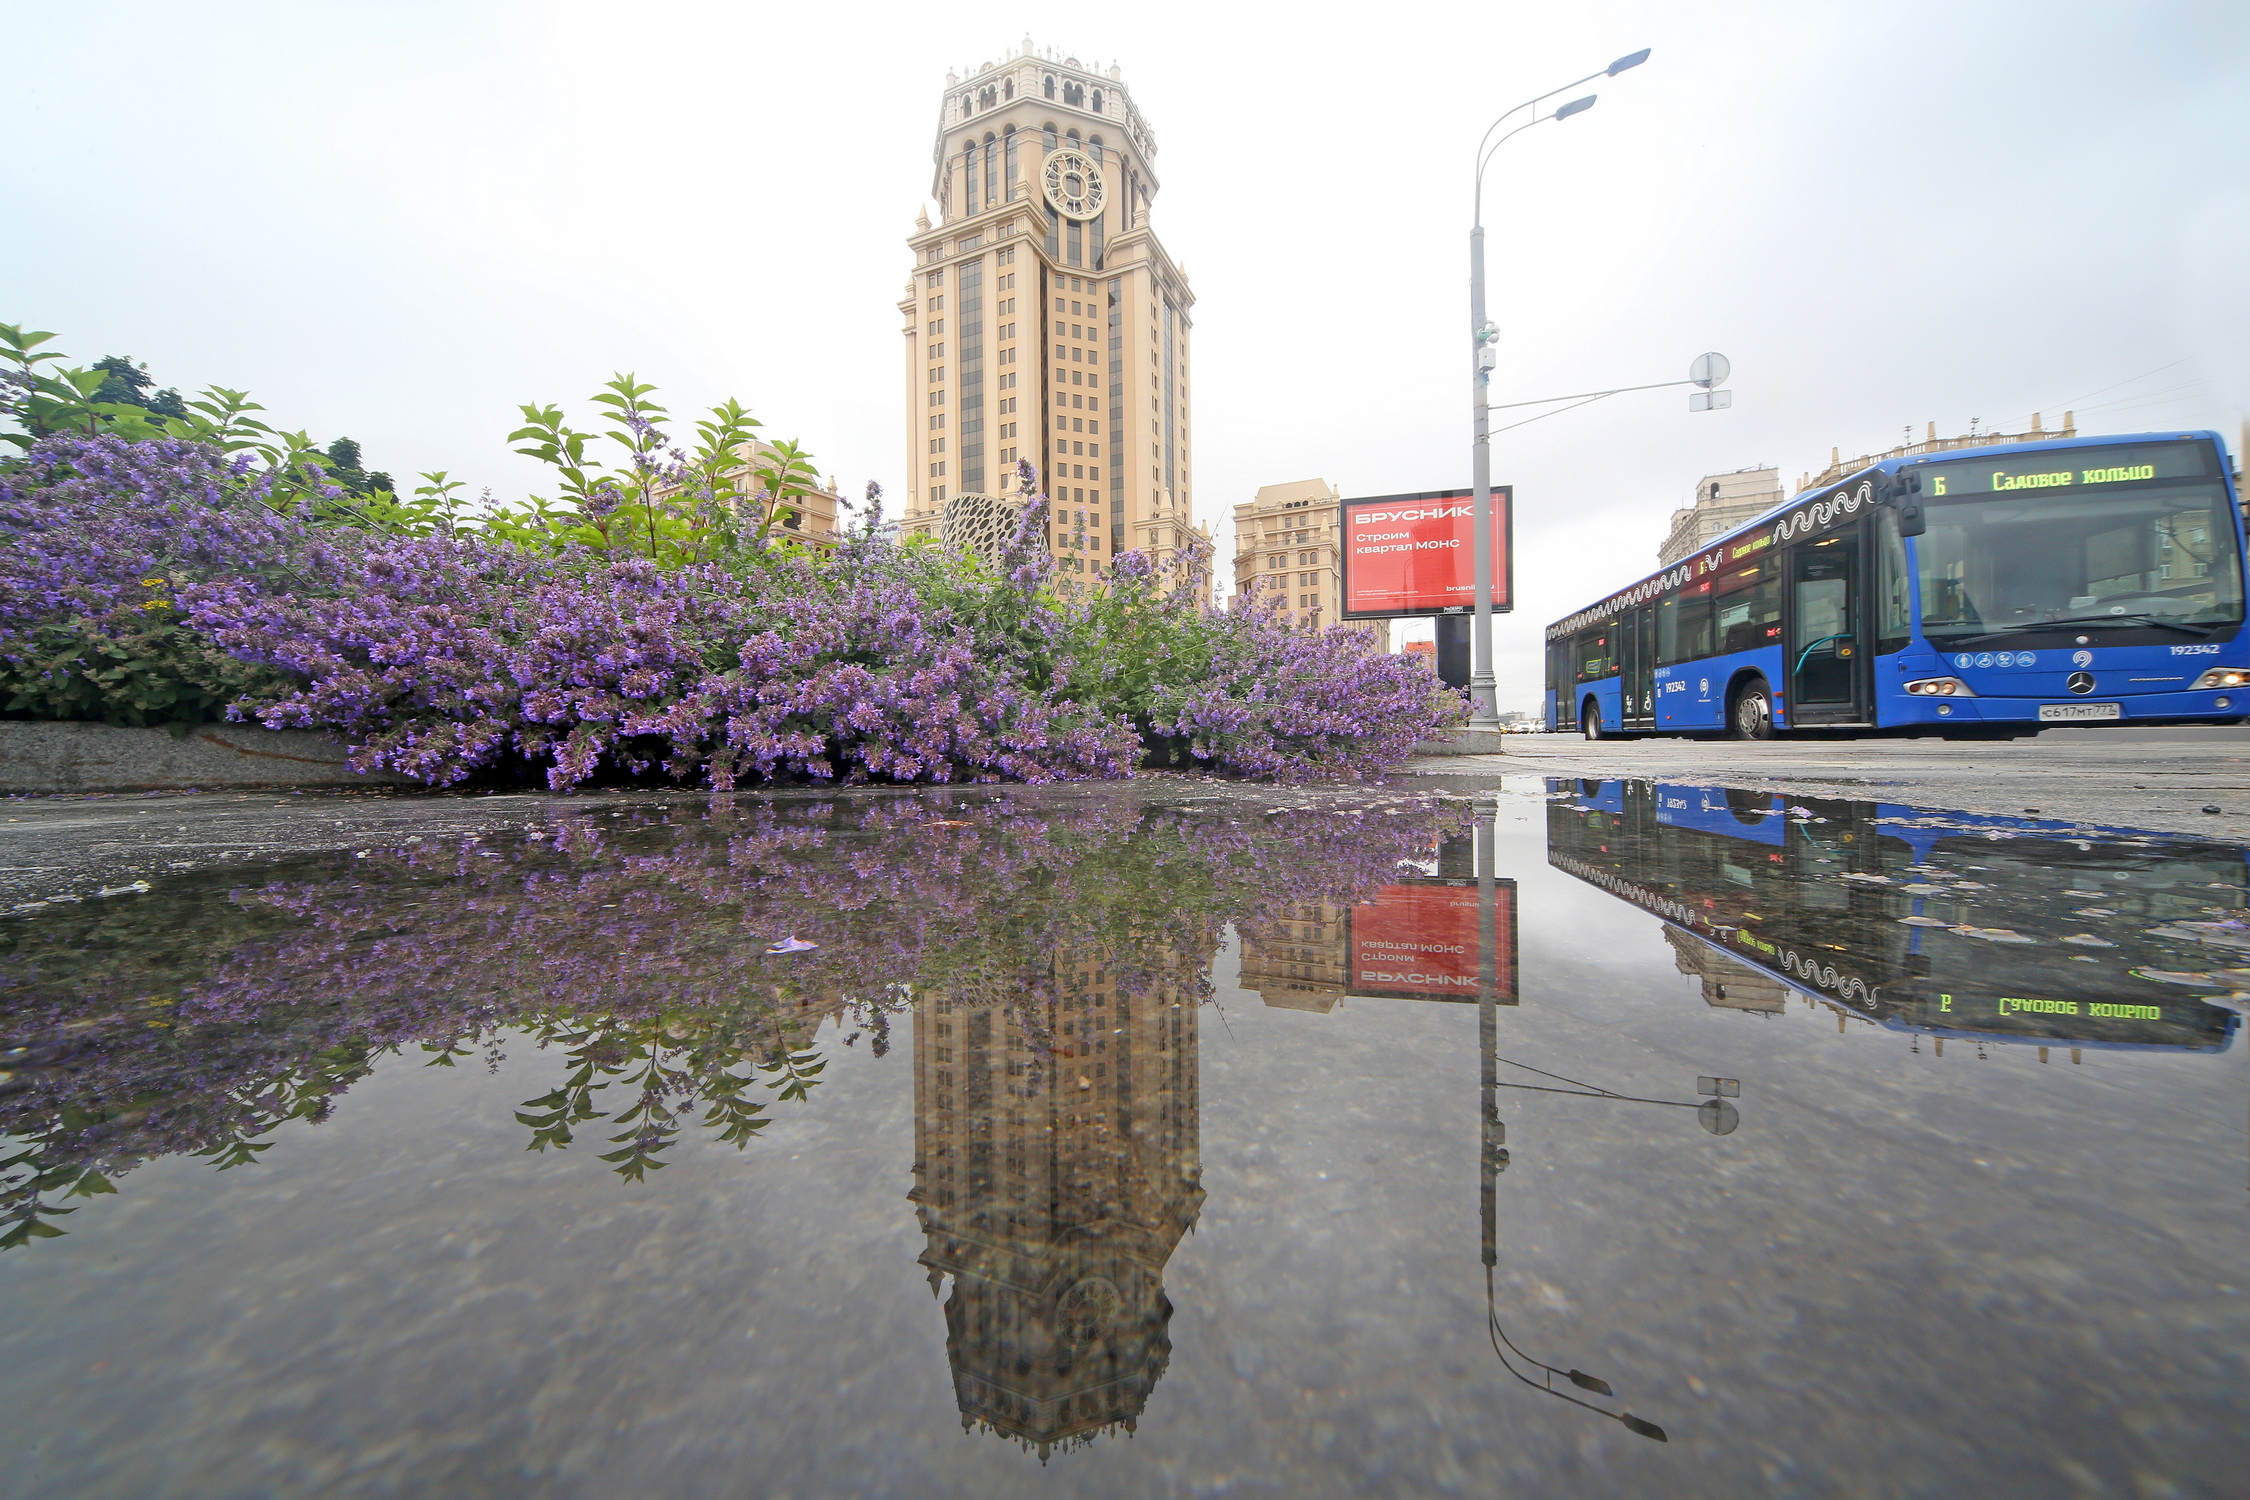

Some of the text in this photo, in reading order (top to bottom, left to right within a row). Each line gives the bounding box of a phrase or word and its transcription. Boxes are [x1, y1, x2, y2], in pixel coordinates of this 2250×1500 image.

[1933, 464, 2155, 496] Б Садовое кольцо
[1355, 506, 1494, 525] БРУСНИК
[1356, 531, 1410, 543] Строим
[1356, 539, 1461, 556] квартал МОНС
[2169, 644, 2221, 656] 192342
[1665, 680, 1686, 694] 192342
